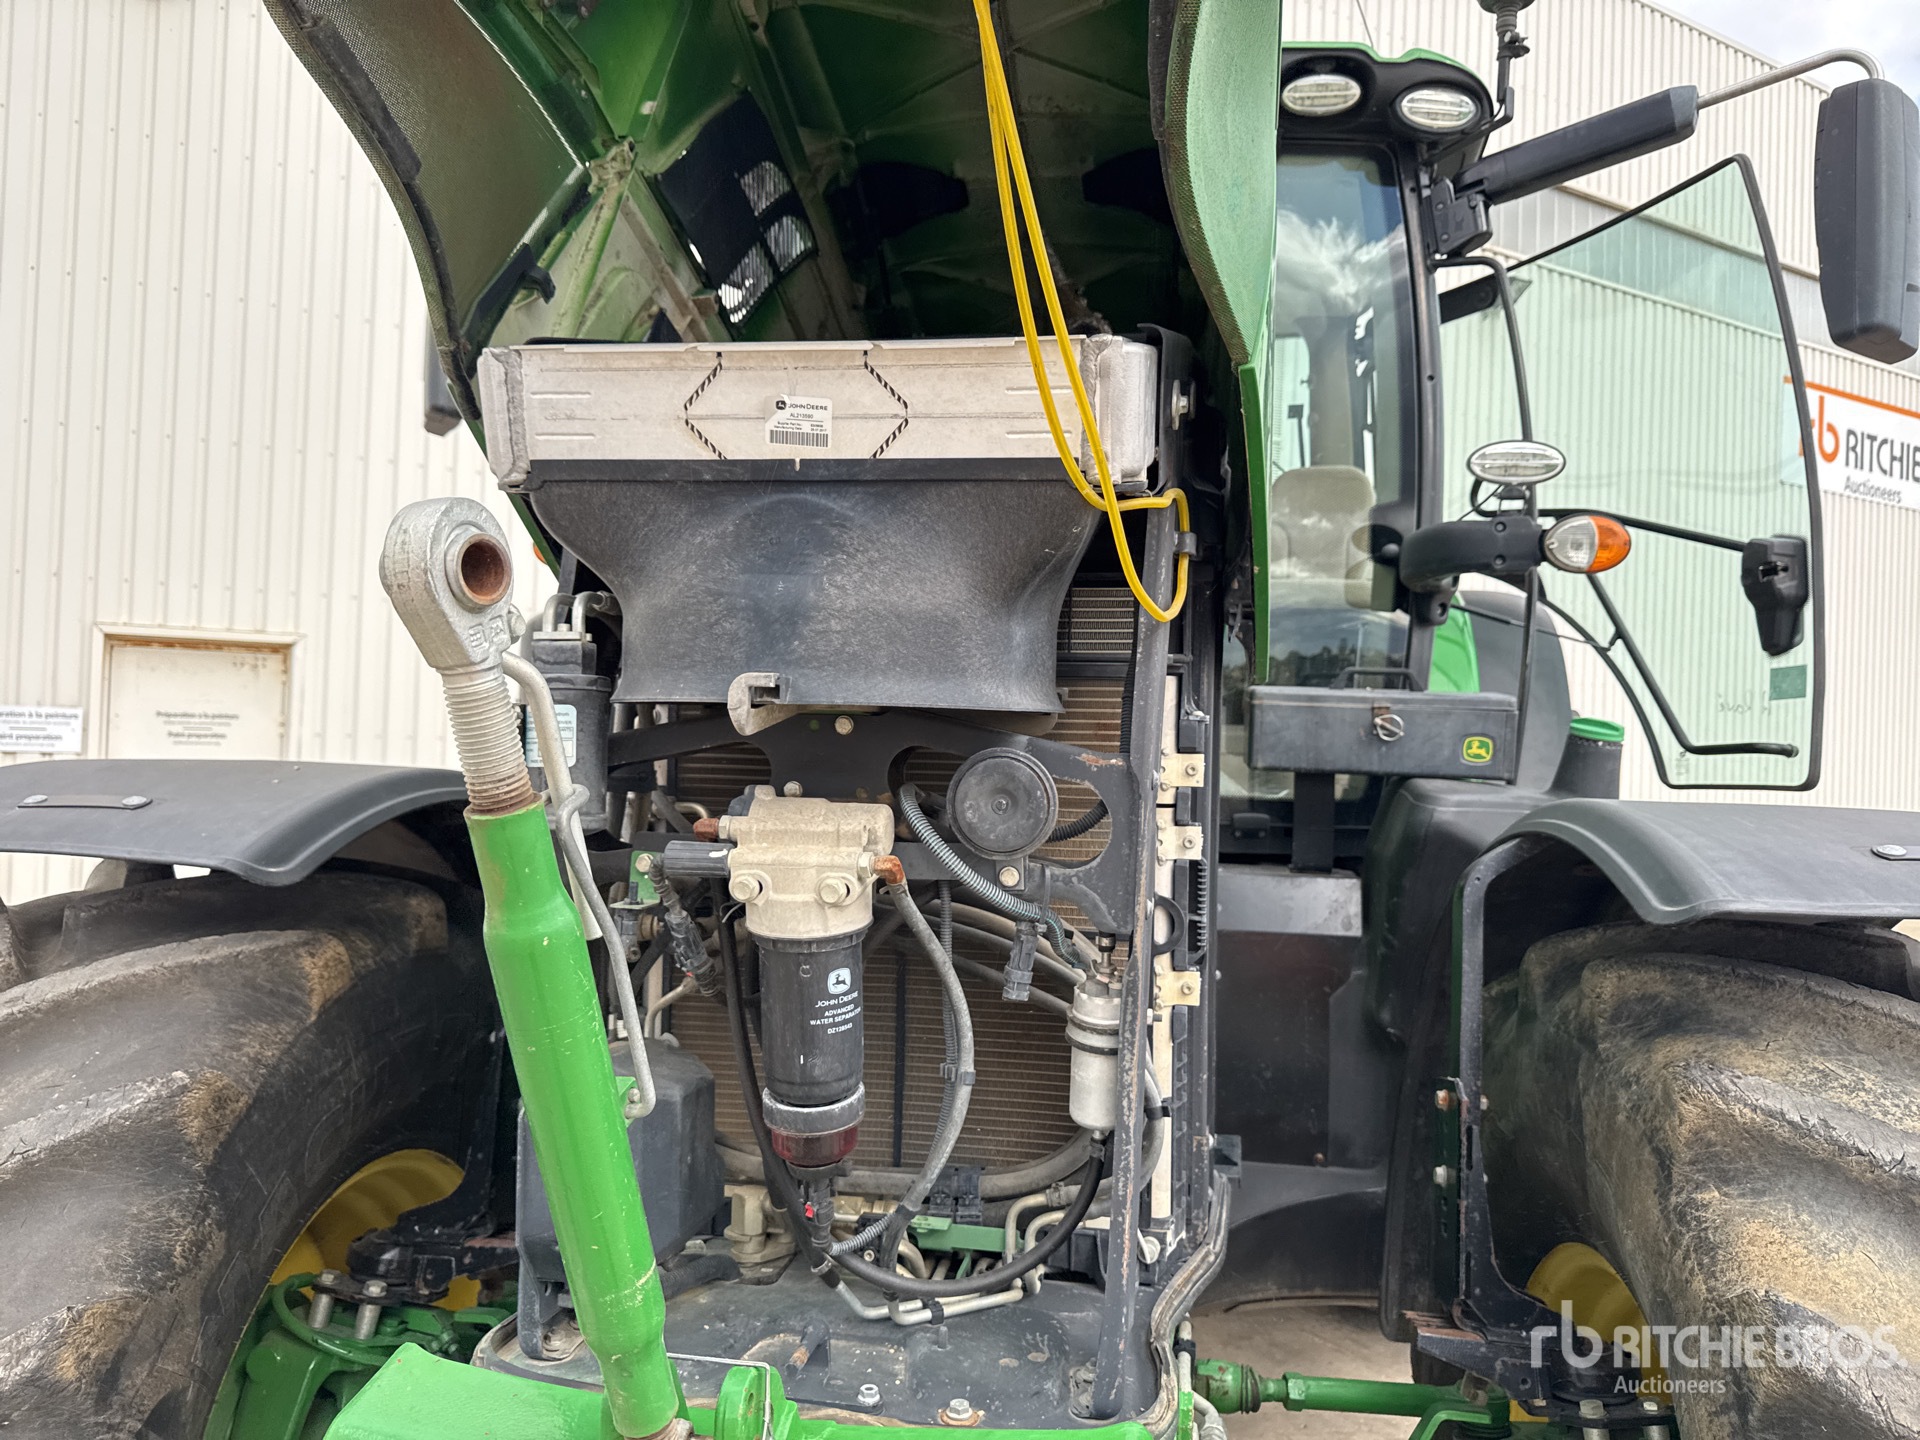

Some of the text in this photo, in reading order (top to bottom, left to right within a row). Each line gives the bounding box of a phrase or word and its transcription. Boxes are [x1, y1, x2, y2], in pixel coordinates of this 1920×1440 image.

[1845, 428, 1920, 484] RITCHIE
[1844, 475, 1903, 503] Auctioneers
[815, 991, 858, 1008] JOHN DEERE
[824, 1004, 855, 1017] ADVANCED
[809, 1018, 834, 1026] WATER
